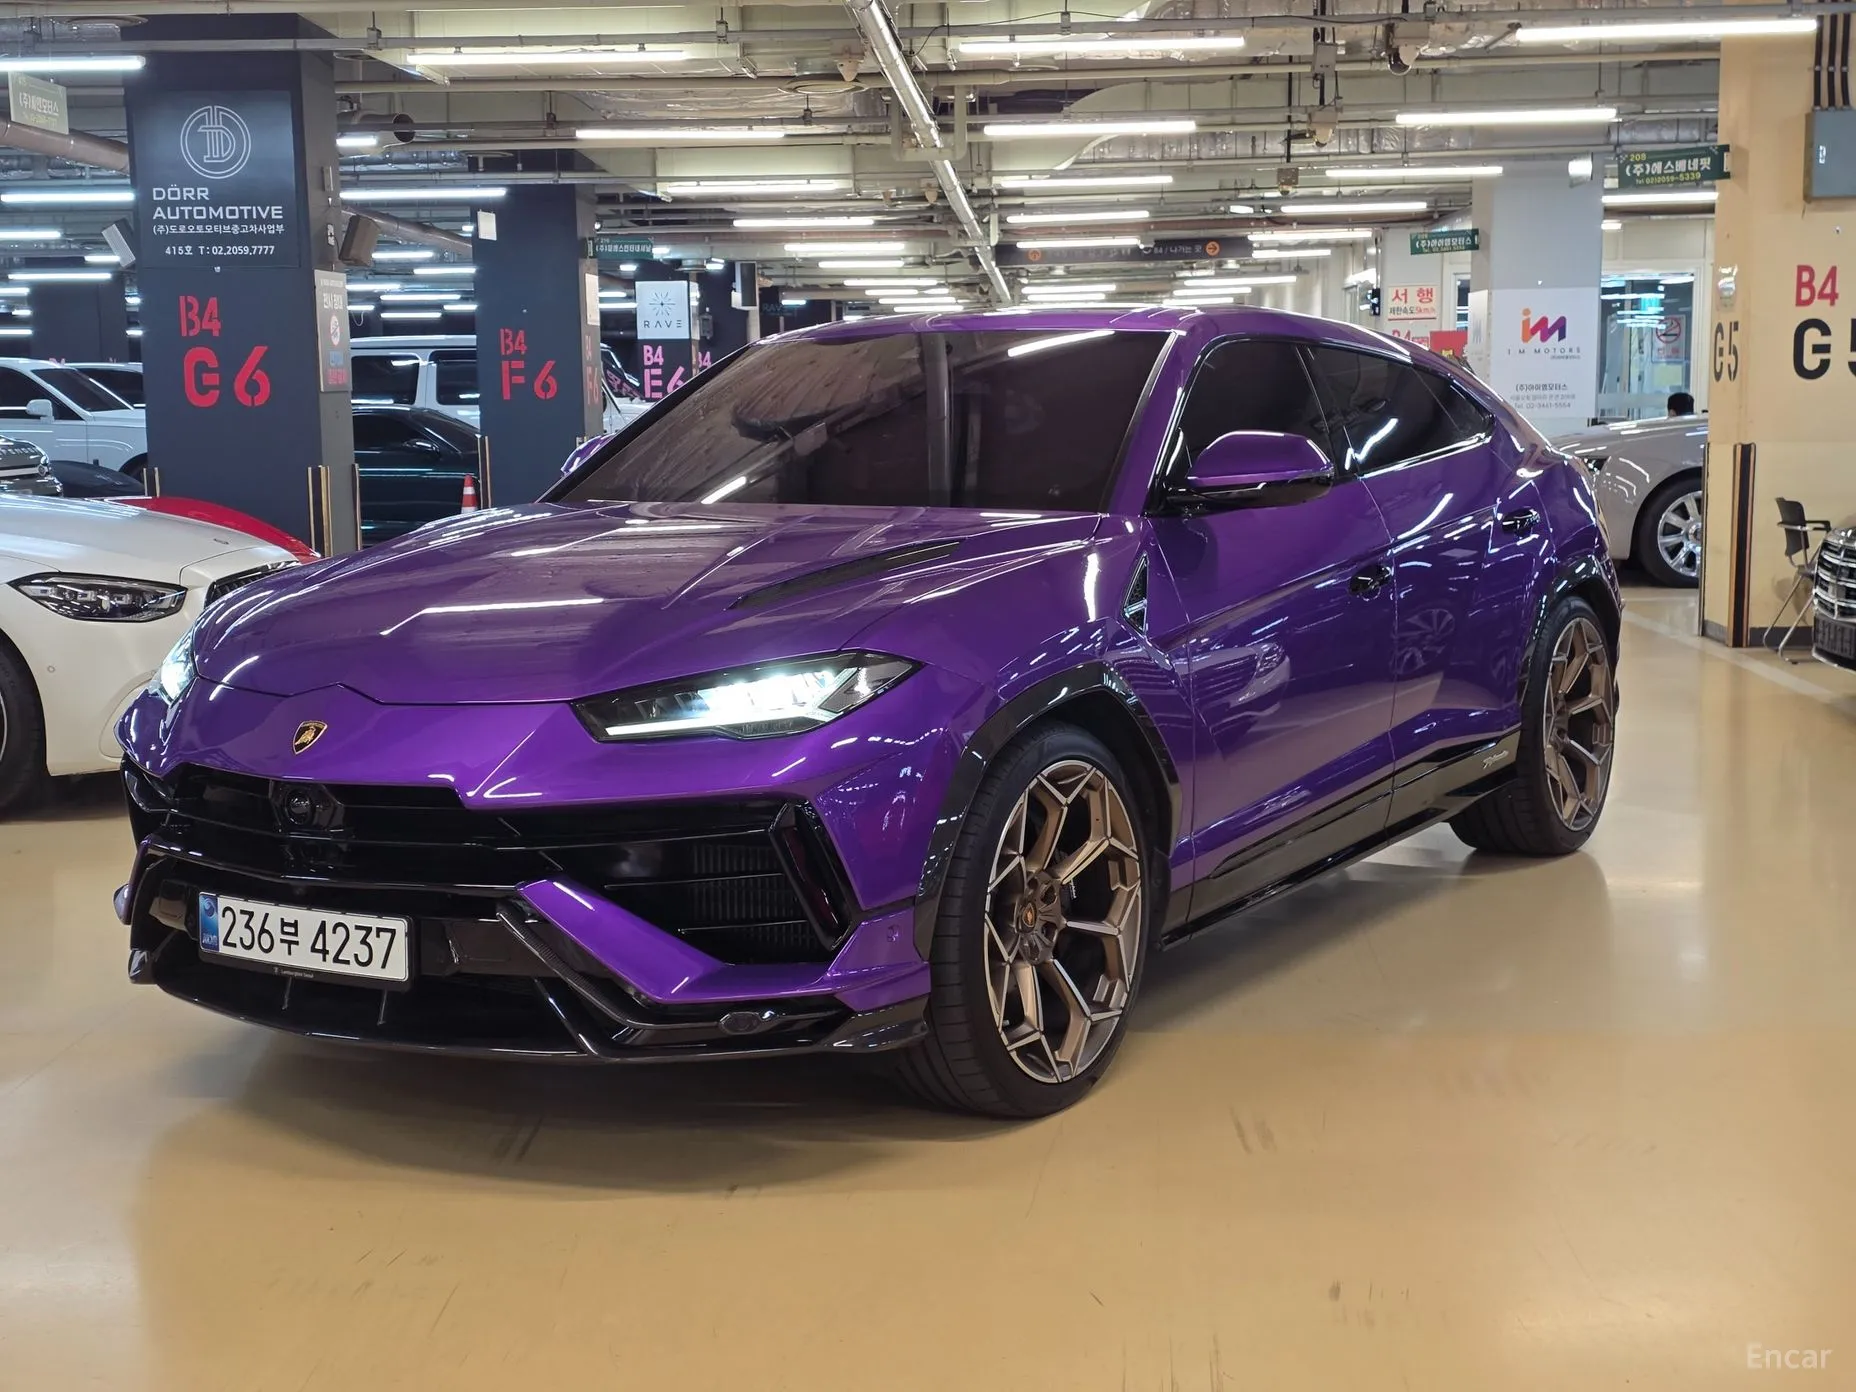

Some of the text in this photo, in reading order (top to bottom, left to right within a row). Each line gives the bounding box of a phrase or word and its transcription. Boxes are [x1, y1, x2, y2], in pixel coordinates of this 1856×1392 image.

[1629, 153, 1647, 161] 208
[1625, 157, 1711, 177] (주)에스베네핏
[152, 184, 210, 201] DÖRR
[152, 206, 284, 220] AUTOMOTIVE
[165, 245, 193, 256] 415호
[1795, 264, 1839, 307] B4
[179, 295, 222, 337] B4
[643, 320, 683, 328] RAVE
[500, 328, 527, 355] B4
[643, 344, 664, 365] B4
[1515, 383, 1568, 392] (주)아이엠모터스
[221, 905, 397, 970] 236부 4237
